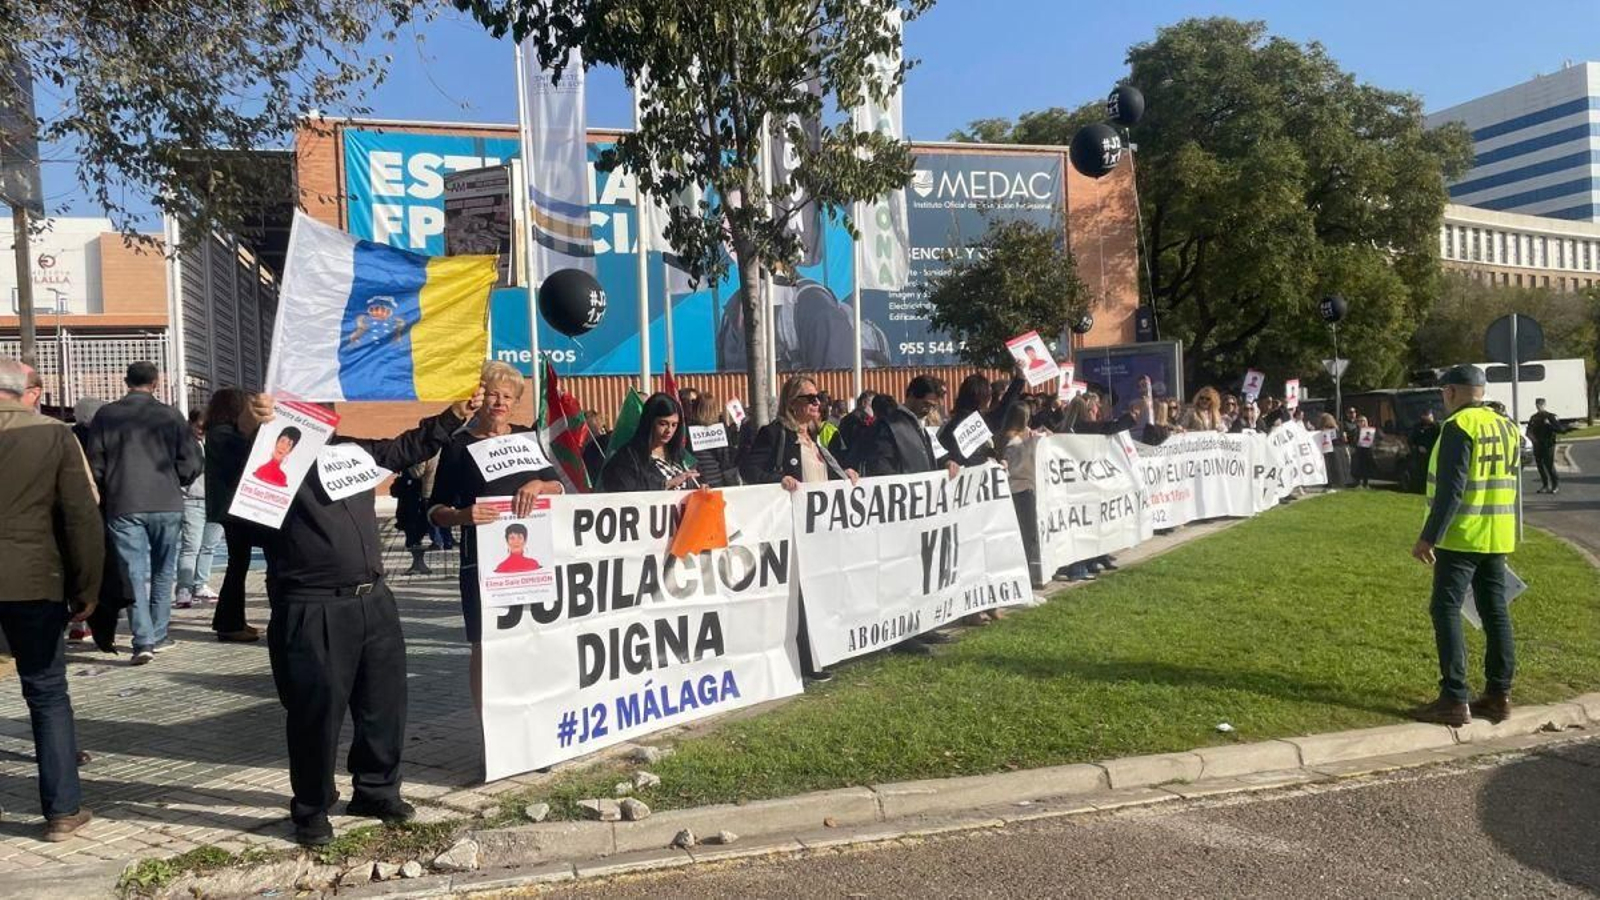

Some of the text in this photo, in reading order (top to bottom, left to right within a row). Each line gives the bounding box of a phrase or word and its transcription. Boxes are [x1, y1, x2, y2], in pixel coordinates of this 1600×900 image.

[937, 170, 1052, 199] MEDAC
[913, 201, 942, 209] Instituto
[944, 201, 967, 209] Oficial
[372, 204, 446, 249] FP
[965, 247, 976, 260] Y
[889, 291, 917, 299] Imagen
[899, 341, 925, 355] 955
[928, 341, 954, 355] 544
[323, 457, 362, 473] MUTUA
[485, 456, 543, 474] CULPABLE
[489, 444, 530, 458] MUTUA
[325, 468, 380, 492] CULPABLE
[805, 477, 949, 534] PASARELA
[952, 472, 974, 510] AL
[1101, 493, 1134, 523] RETA
[572, 505, 640, 546] POR
[920, 522, 959, 596] YA!
[848, 610, 921, 652] ABOGADOS
[934, 597, 953, 623] #J2
[576, 610, 726, 690] DIGNA
[557, 670, 741, 748] #J2 MÁLAGA
